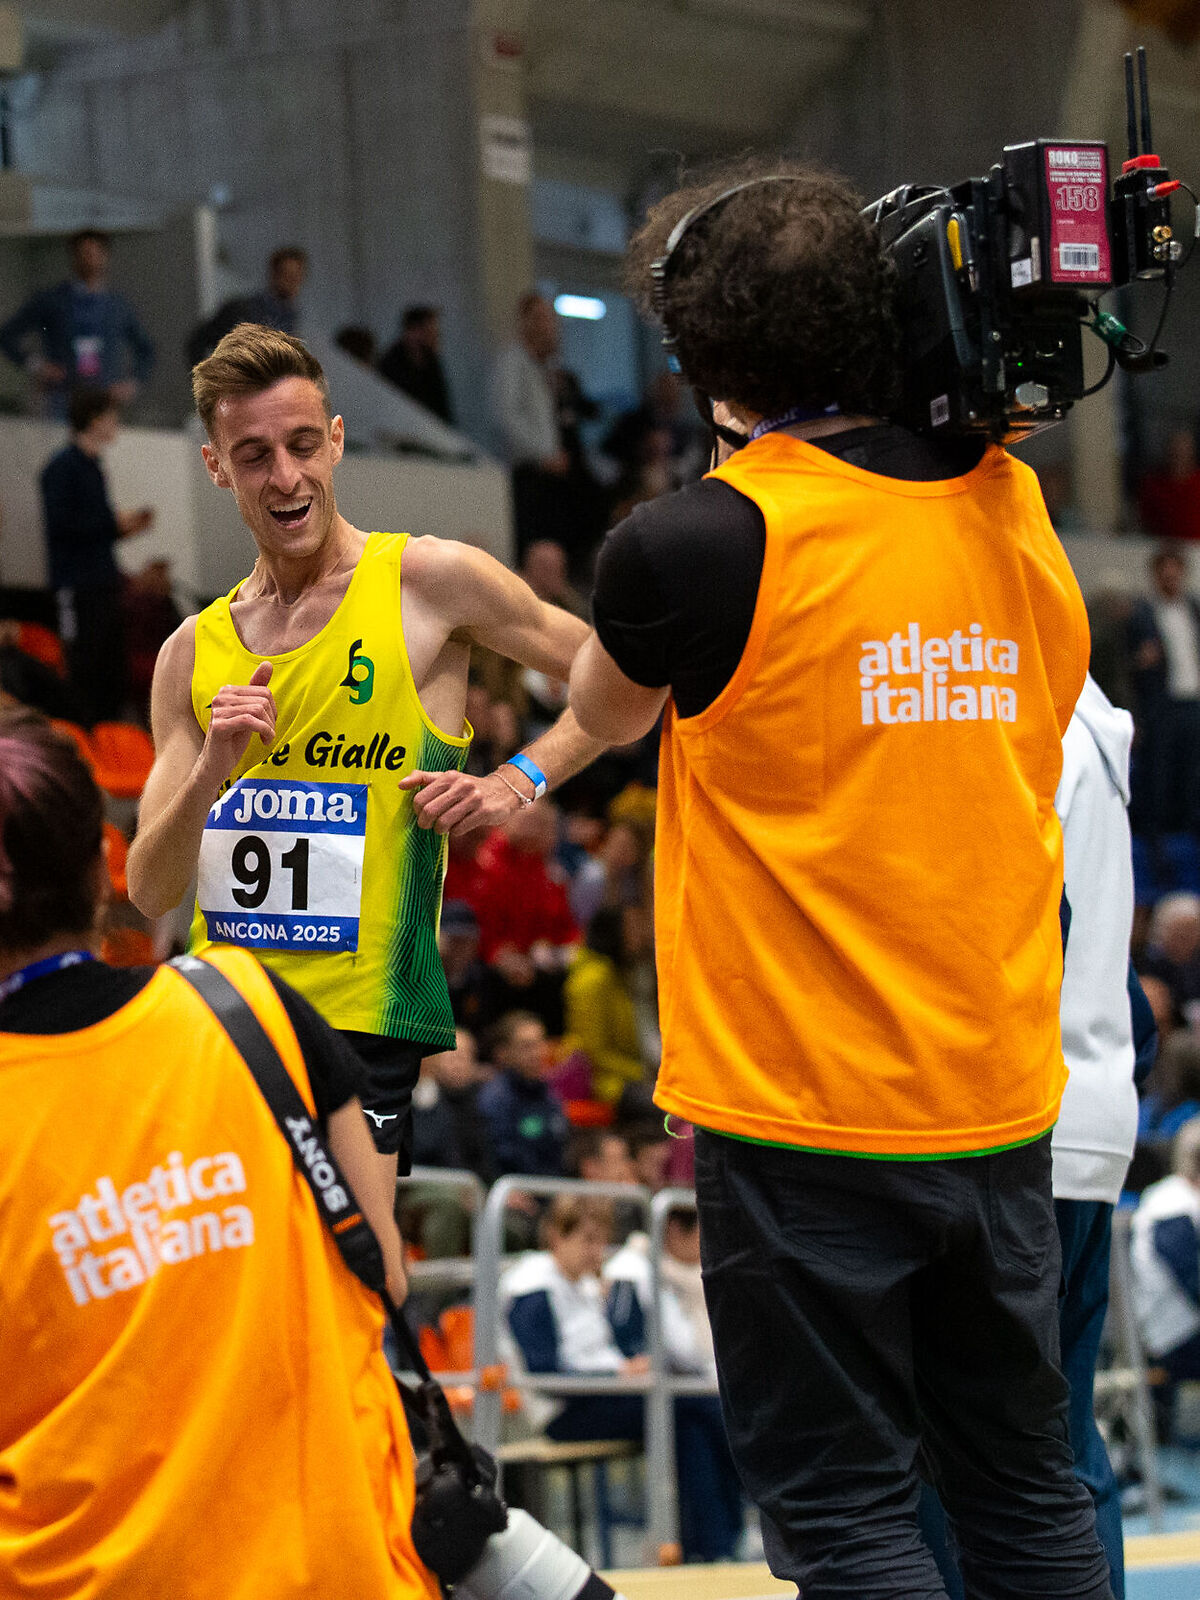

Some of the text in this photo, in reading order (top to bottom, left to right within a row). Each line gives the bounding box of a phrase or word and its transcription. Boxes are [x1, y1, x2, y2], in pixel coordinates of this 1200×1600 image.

[859, 622, 1019, 676] atletica
[859, 671, 1017, 725] italiana
[304, 731, 407, 771] Gialle
[231, 834, 310, 911] 91
[215, 921, 342, 943] ANCONA 2025
[285, 1116, 350, 1213] SONY
[48, 1150, 247, 1254] atletica
